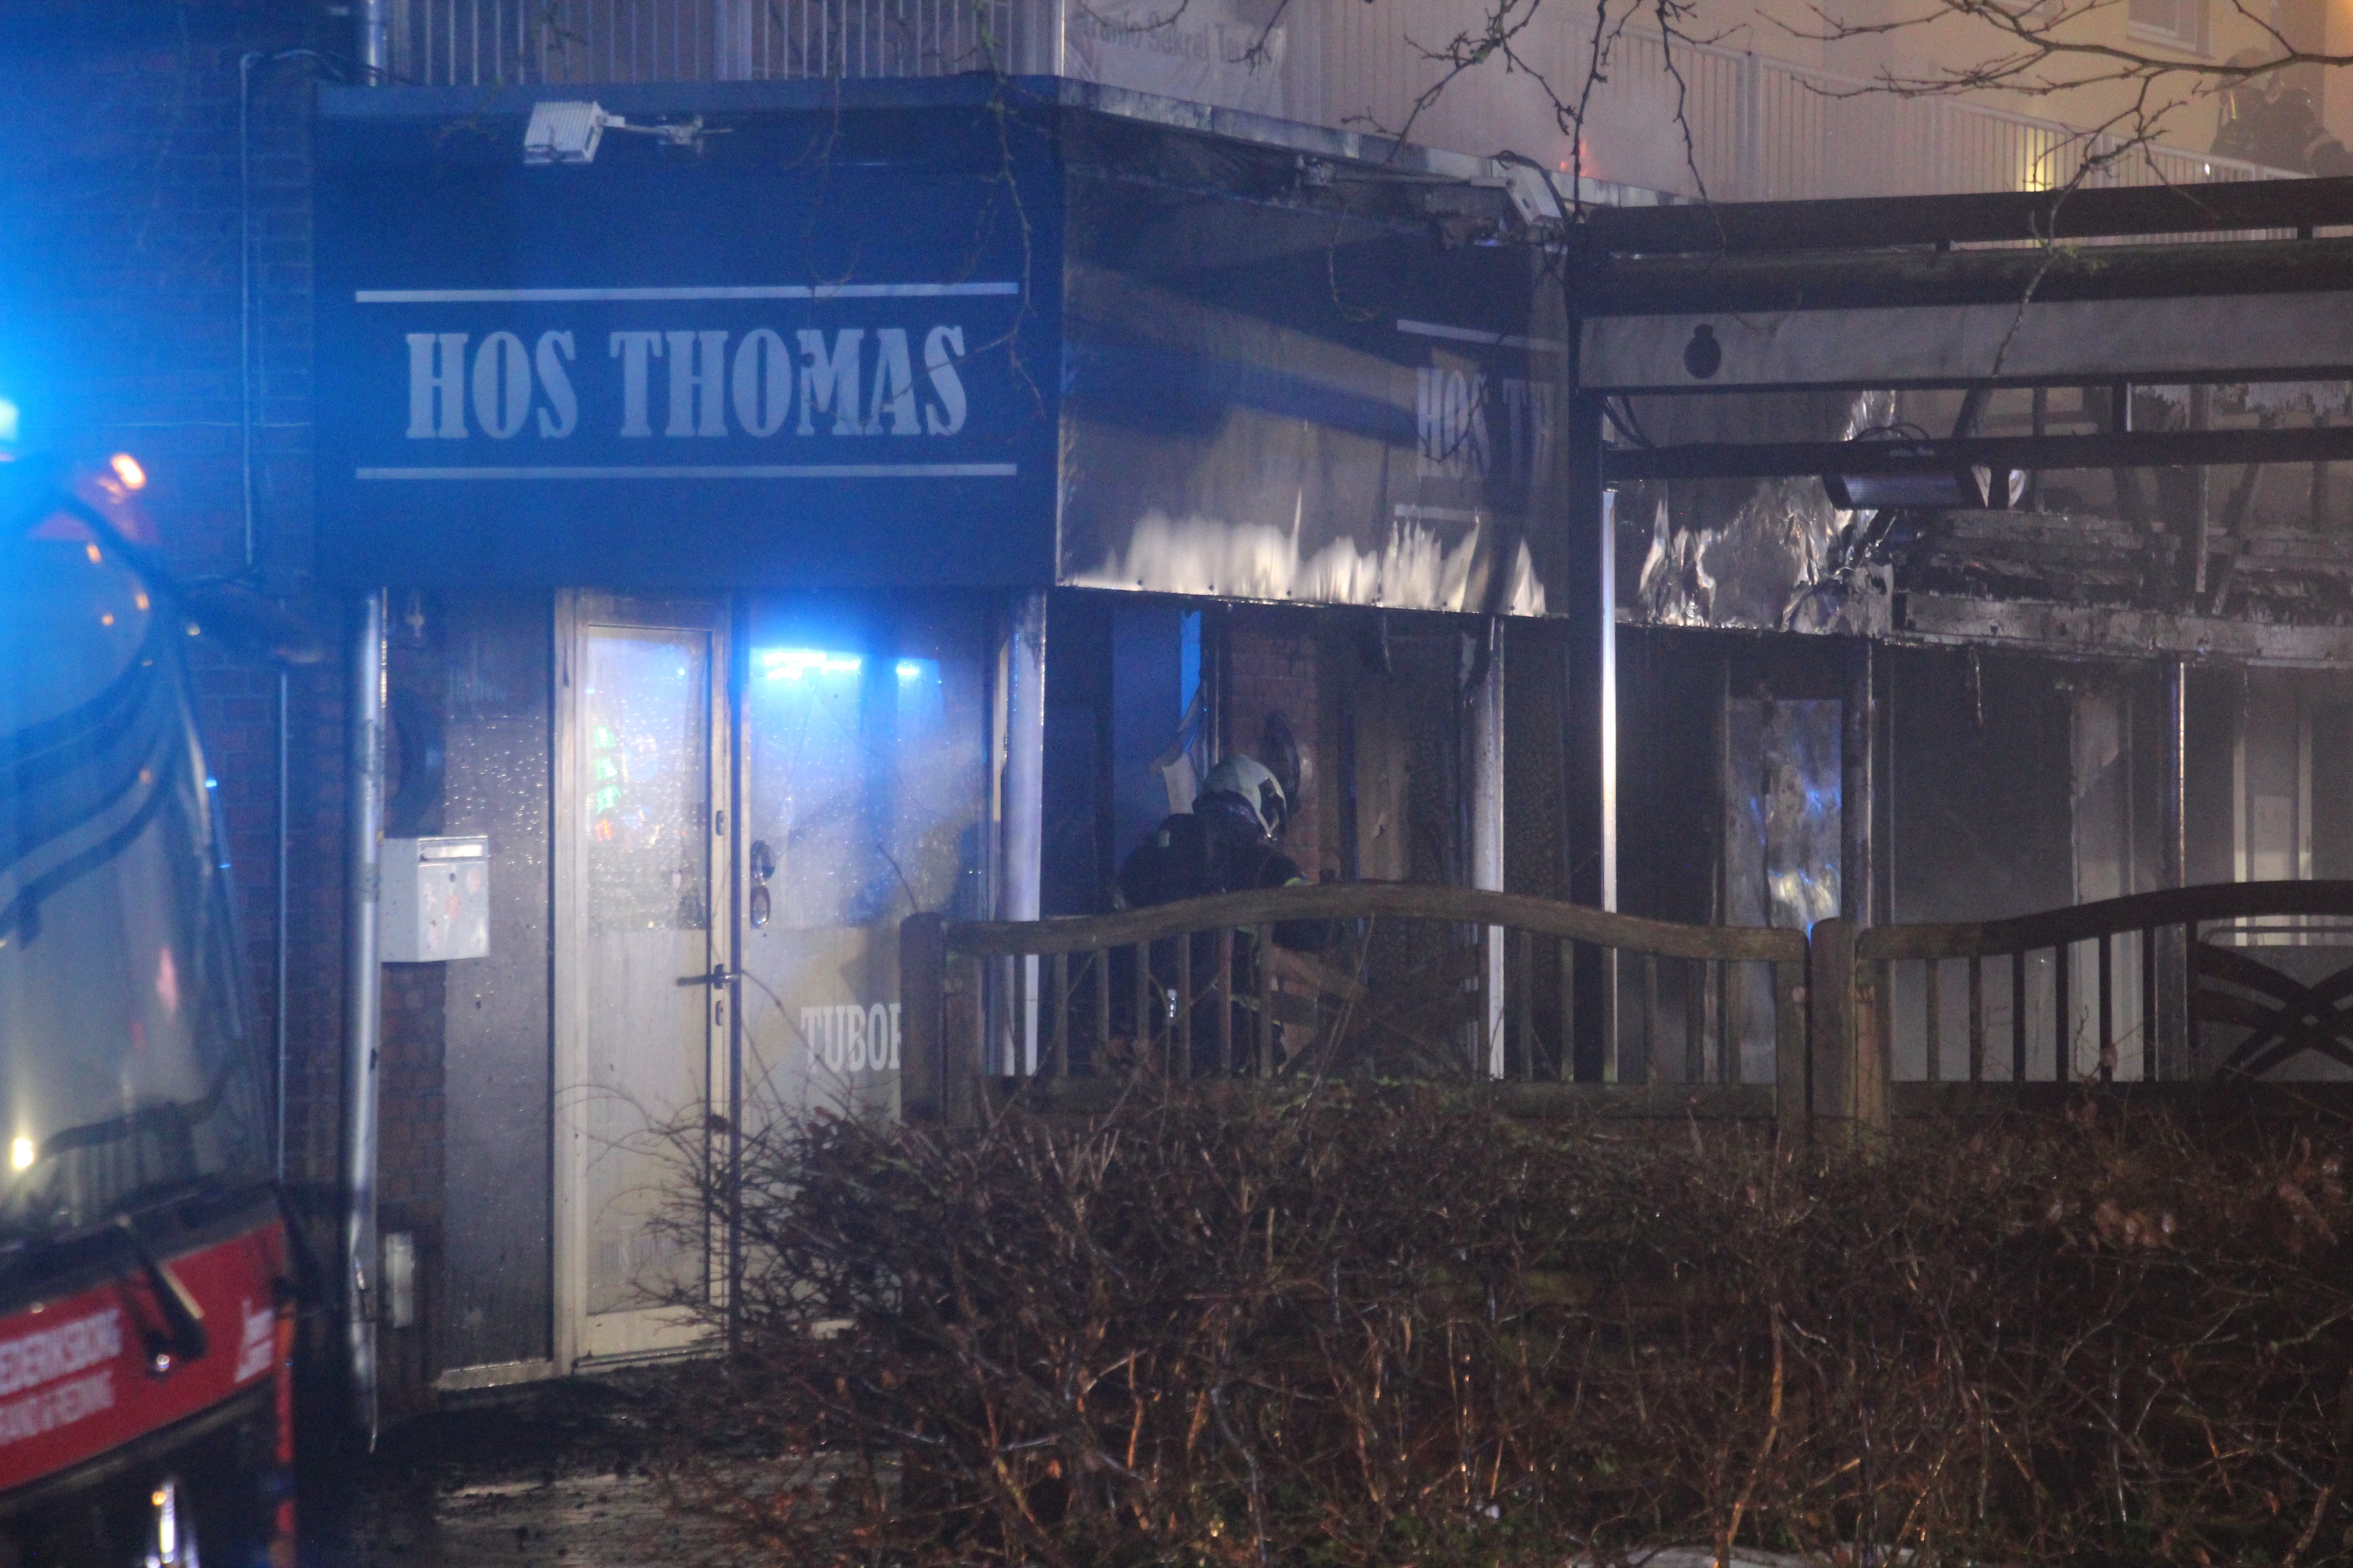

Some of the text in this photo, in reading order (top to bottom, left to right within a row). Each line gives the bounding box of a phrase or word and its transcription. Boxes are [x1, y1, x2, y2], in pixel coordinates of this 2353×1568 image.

[405, 325, 967, 439] HOS THOMAS
[1416, 367, 1490, 481] HOS
